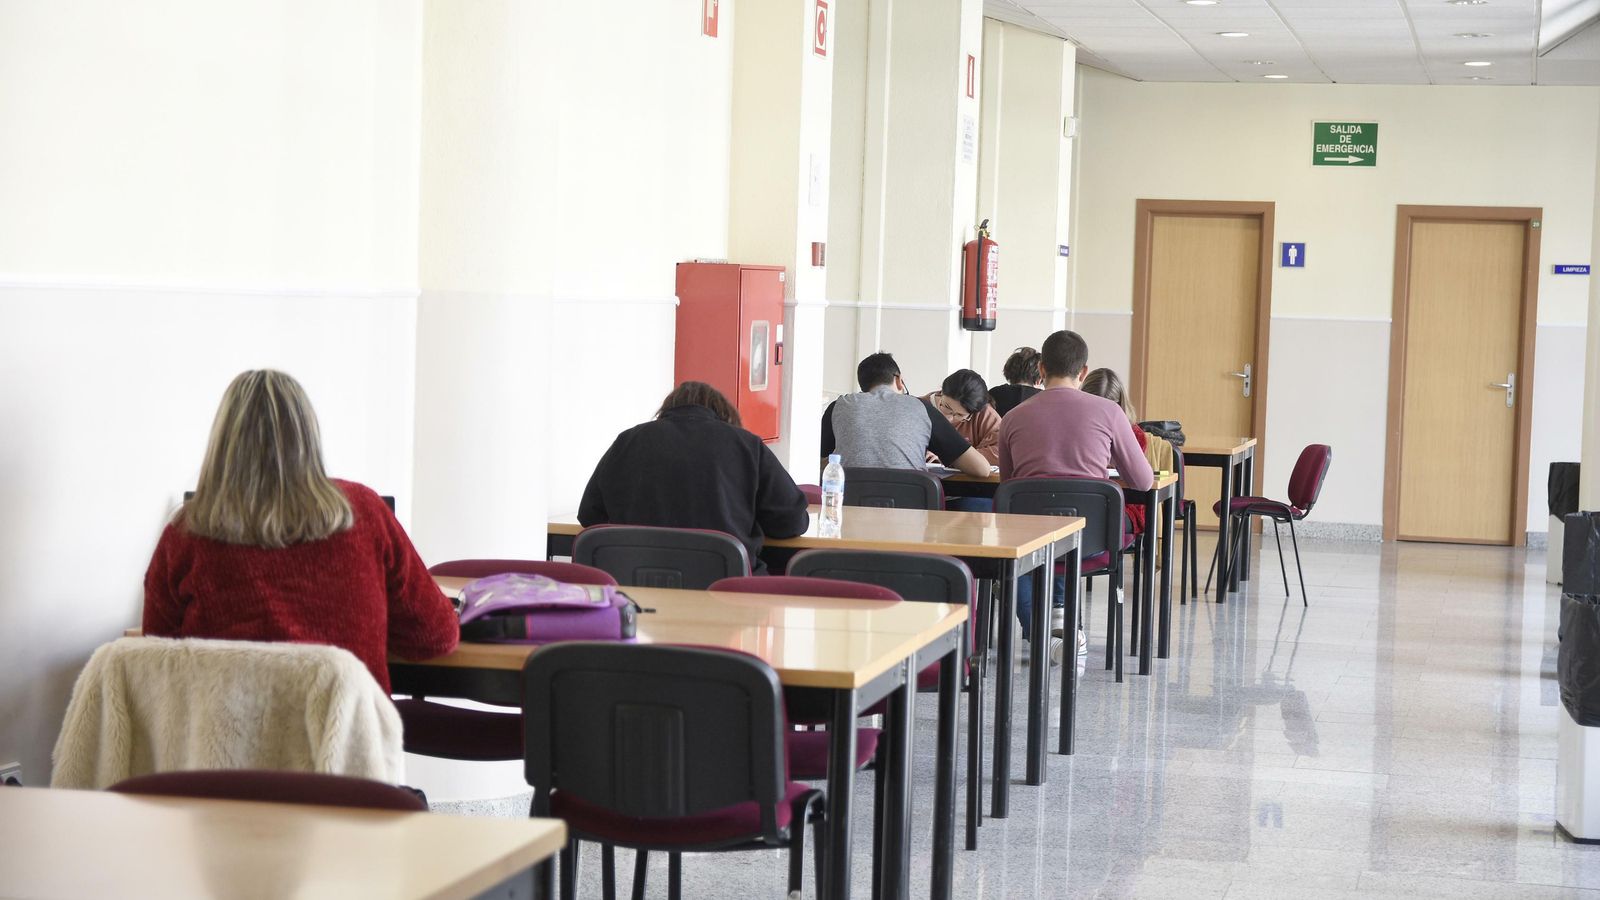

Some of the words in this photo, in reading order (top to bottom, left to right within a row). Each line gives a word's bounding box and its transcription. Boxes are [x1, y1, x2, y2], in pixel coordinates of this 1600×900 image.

[1330, 125, 1362, 134] SALIDA
[1339, 134, 1352, 143] DE
[1316, 144, 1375, 153] EMERGENCIA
